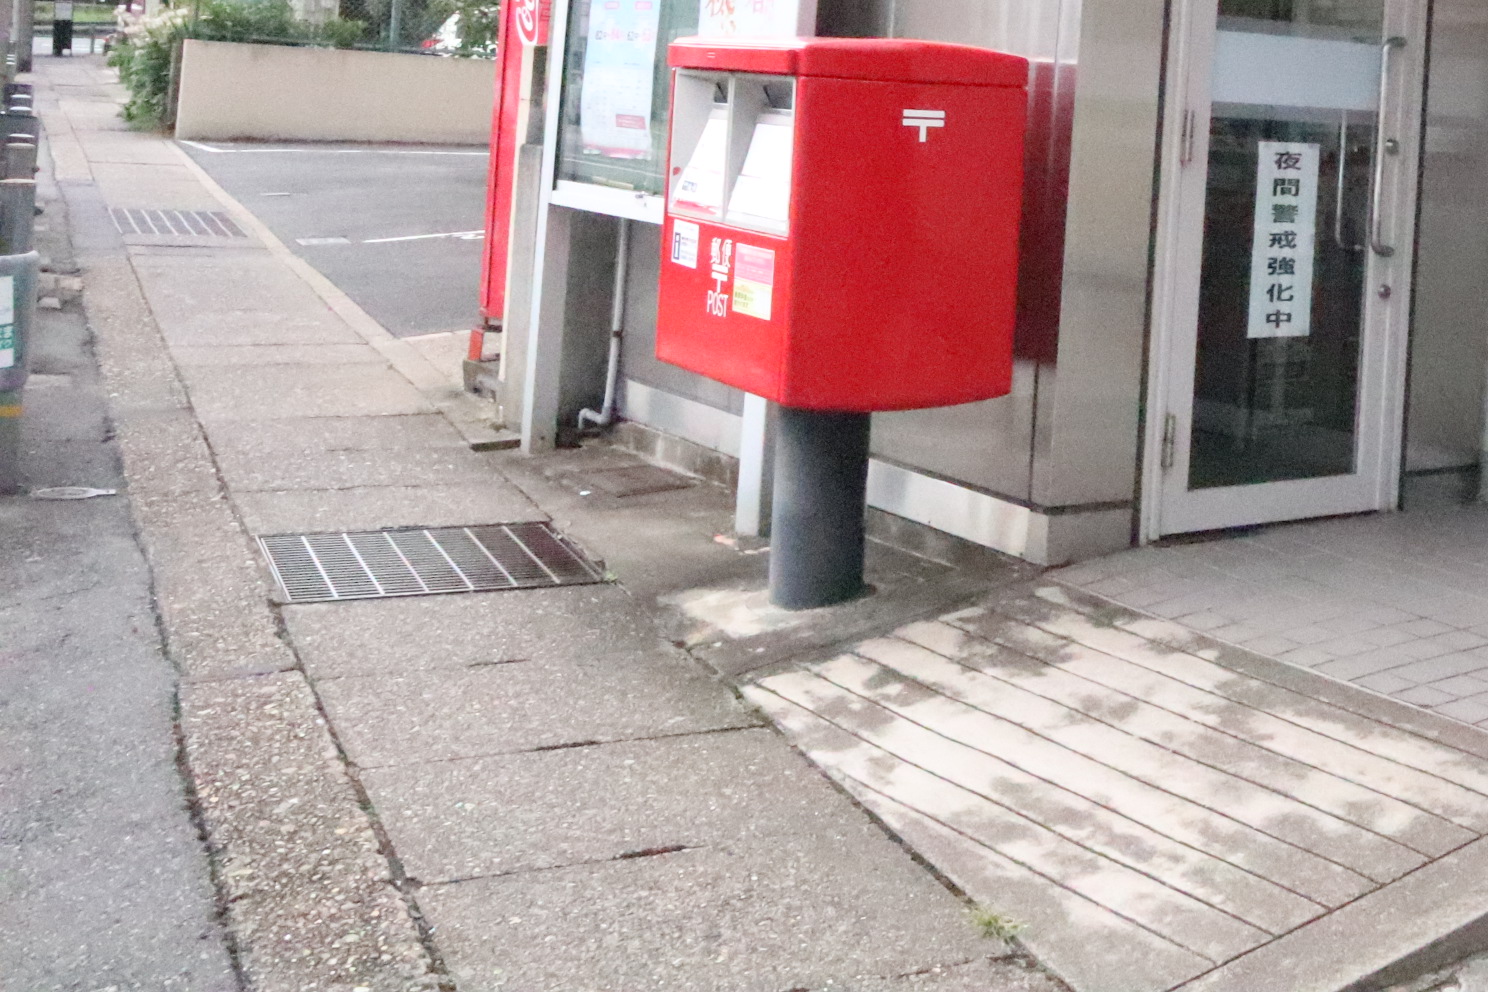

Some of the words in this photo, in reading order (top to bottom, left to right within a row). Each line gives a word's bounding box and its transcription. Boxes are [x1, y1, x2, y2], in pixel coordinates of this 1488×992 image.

[710, 237, 732, 268] 郵便
[1266, 151, 1302, 329] 夜間警戒強化中
[706, 290, 729, 318] POST
